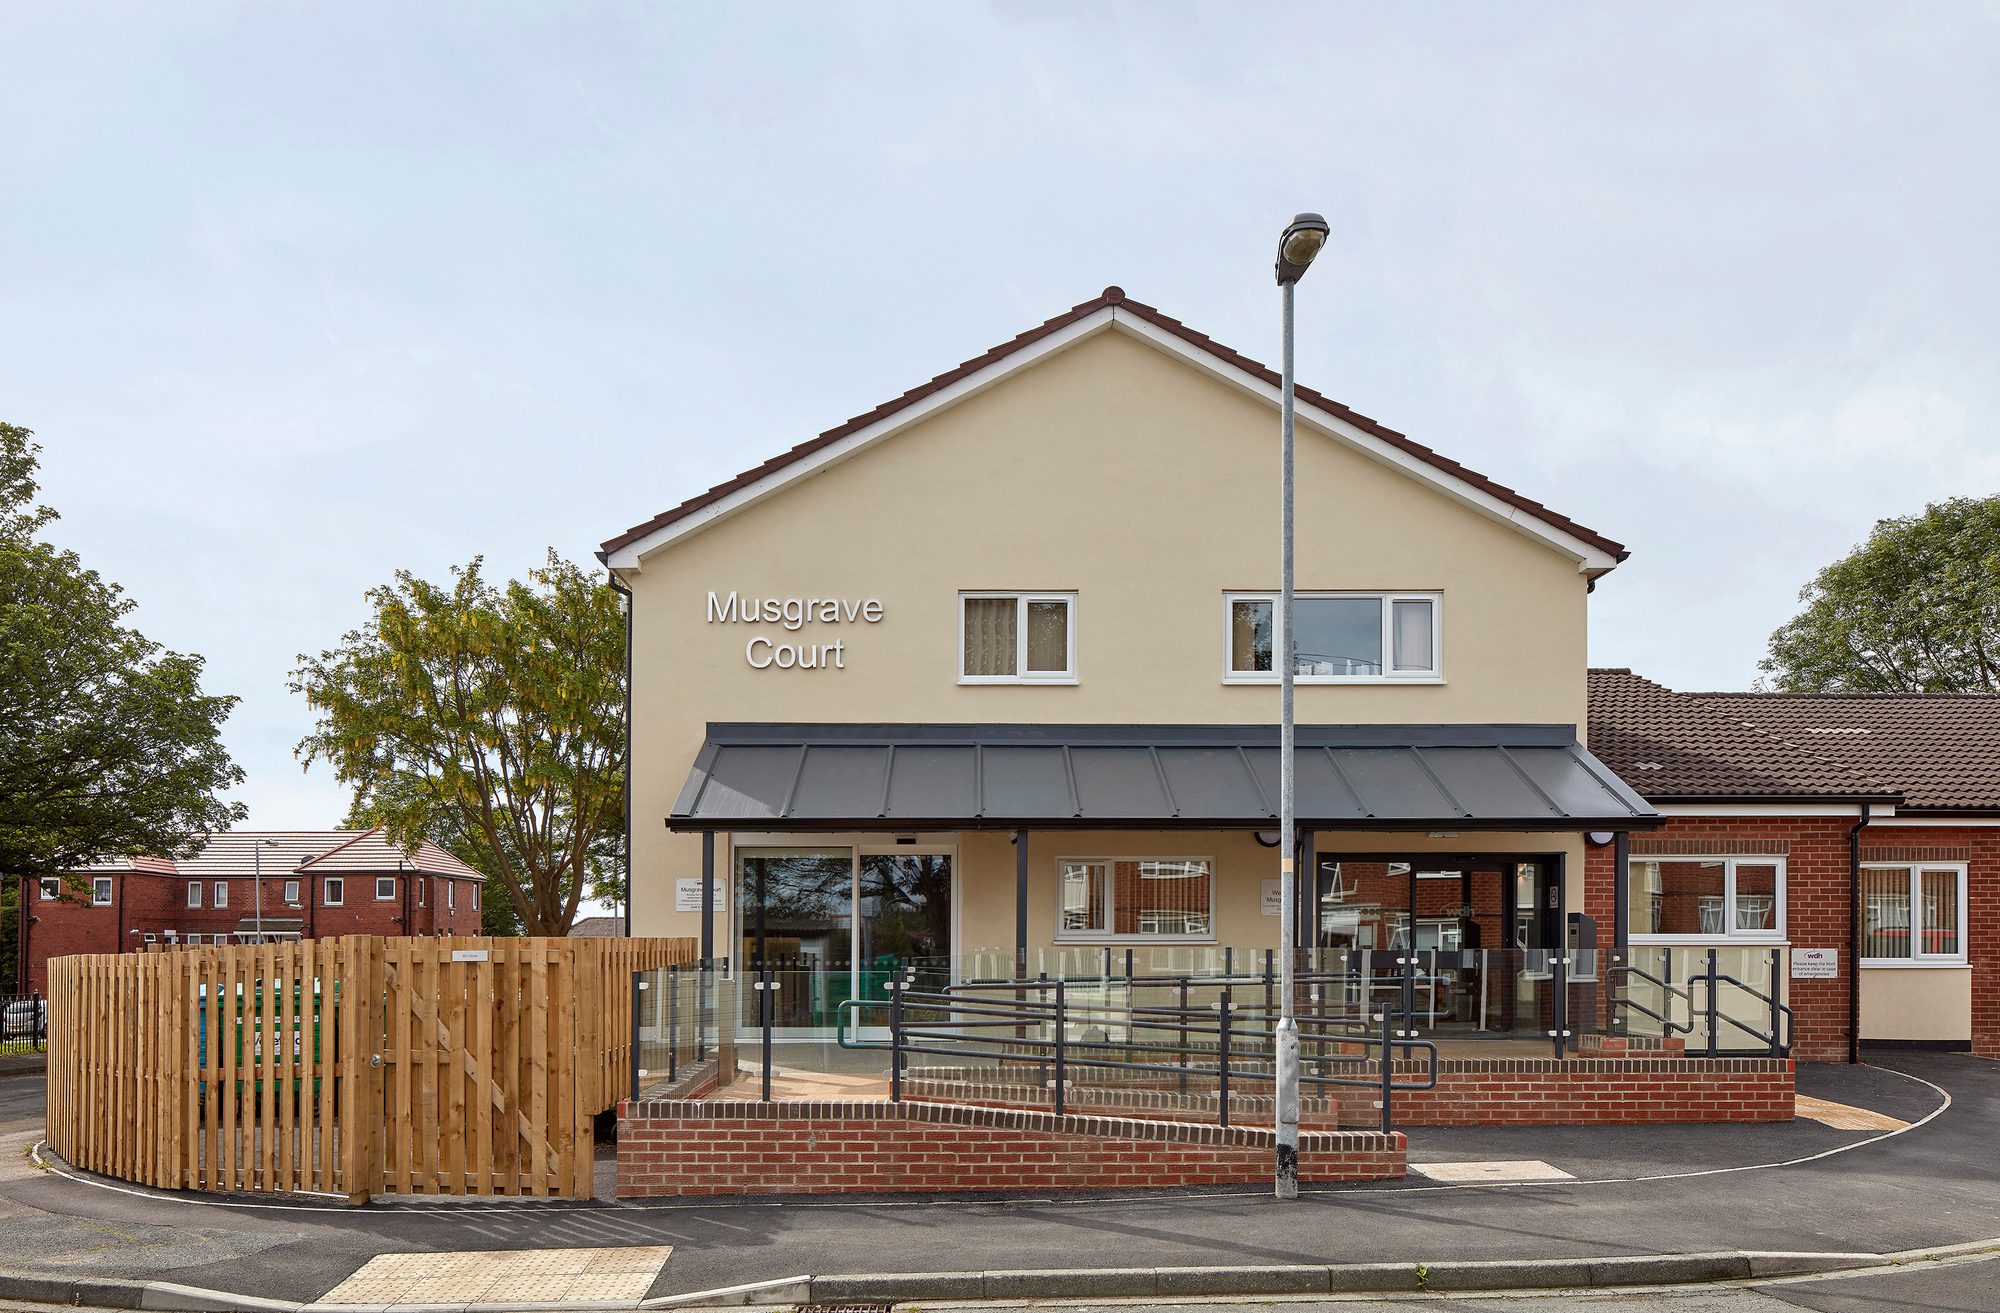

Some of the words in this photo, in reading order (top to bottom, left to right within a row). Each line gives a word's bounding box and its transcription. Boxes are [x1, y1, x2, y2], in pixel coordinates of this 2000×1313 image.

[707, 591, 884, 631] Musgrave
[745, 636, 845, 669] Court
[1266, 896, 1282, 904] Musg
